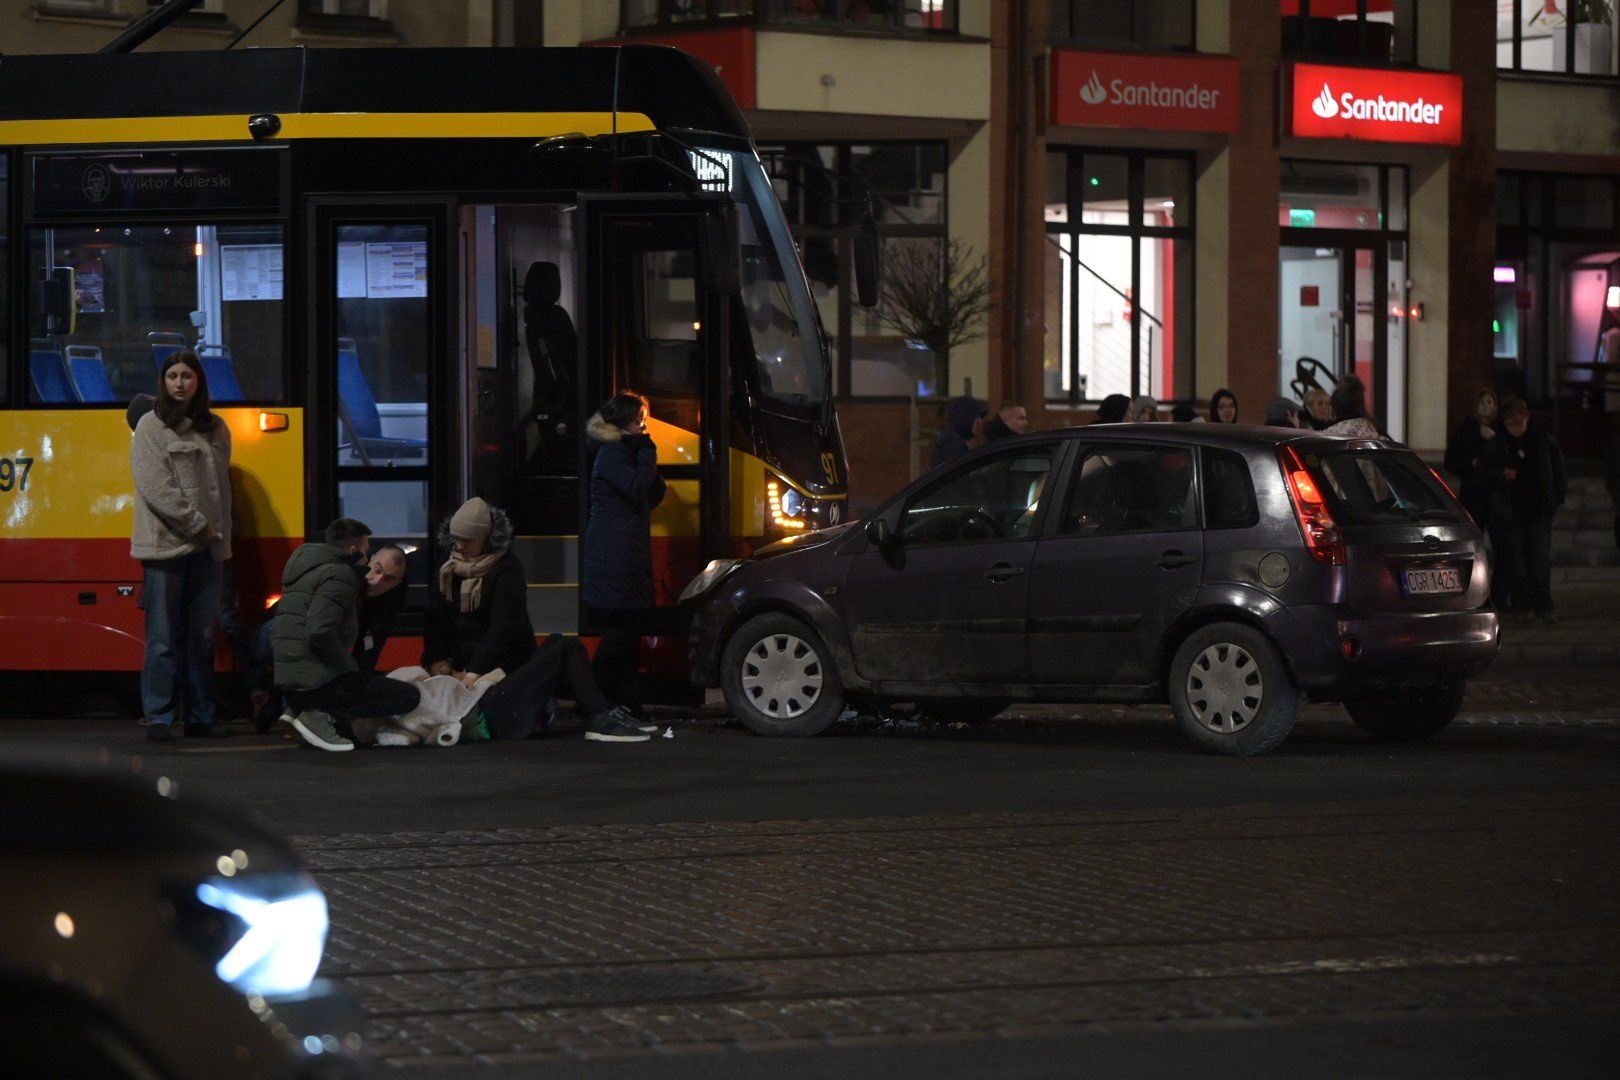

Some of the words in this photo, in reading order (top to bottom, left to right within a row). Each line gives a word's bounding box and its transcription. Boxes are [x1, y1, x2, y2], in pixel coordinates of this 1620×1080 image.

[1110, 79, 1220, 109] Santander
[1340, 92, 1443, 124] Santander
[121, 175, 169, 191] Wiktor
[174, 173, 231, 188] Kulerski
[820, 451, 839, 486] 97
[1407, 571, 1429, 591] CGR
